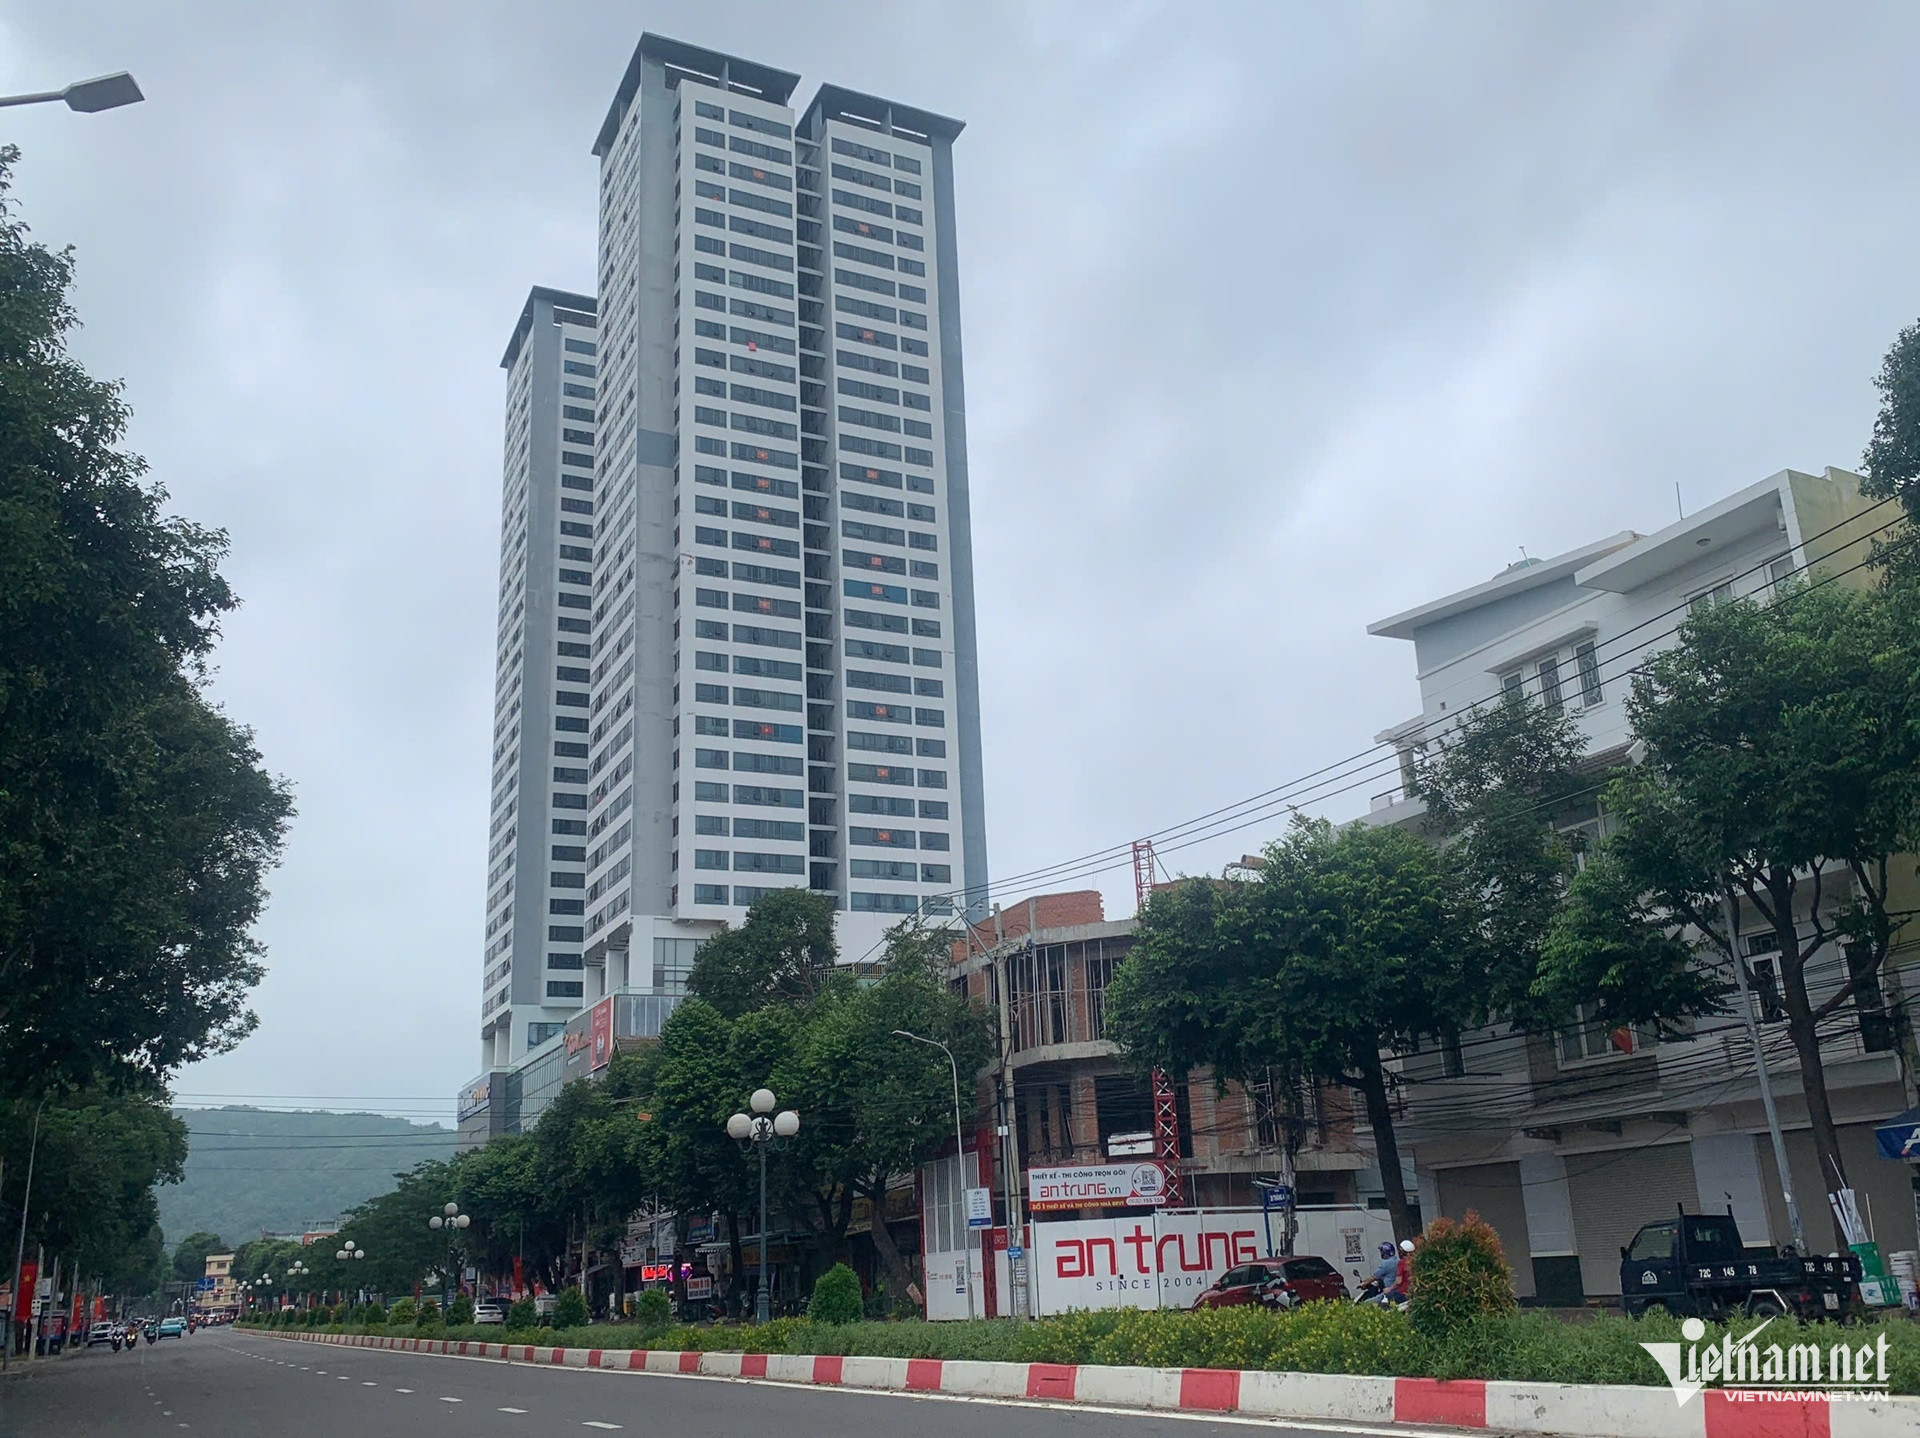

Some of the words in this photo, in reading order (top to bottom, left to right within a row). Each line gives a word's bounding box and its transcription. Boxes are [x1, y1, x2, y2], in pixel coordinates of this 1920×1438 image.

[1032, 1171, 1048, 1180] THIẾT
[1050, 1170, 1057, 1179] KẾ
[1073, 1170, 1093, 1178] CÔNG
[1095, 1170, 1111, 1178] TRỌN
[1699, 1268, 1712, 1278] 72C
[1723, 1266, 1735, 1277] 145
[1748, 1265, 1757, 1275] 78
[1804, 1262, 1816, 1272] 72C
[1823, 1262, 1833, 1272] 145
[1842, 1262, 1850, 1272] 78
[1096, 1279, 1151, 1291] SINCE
[1164, 1277, 1203, 1289] 2004
